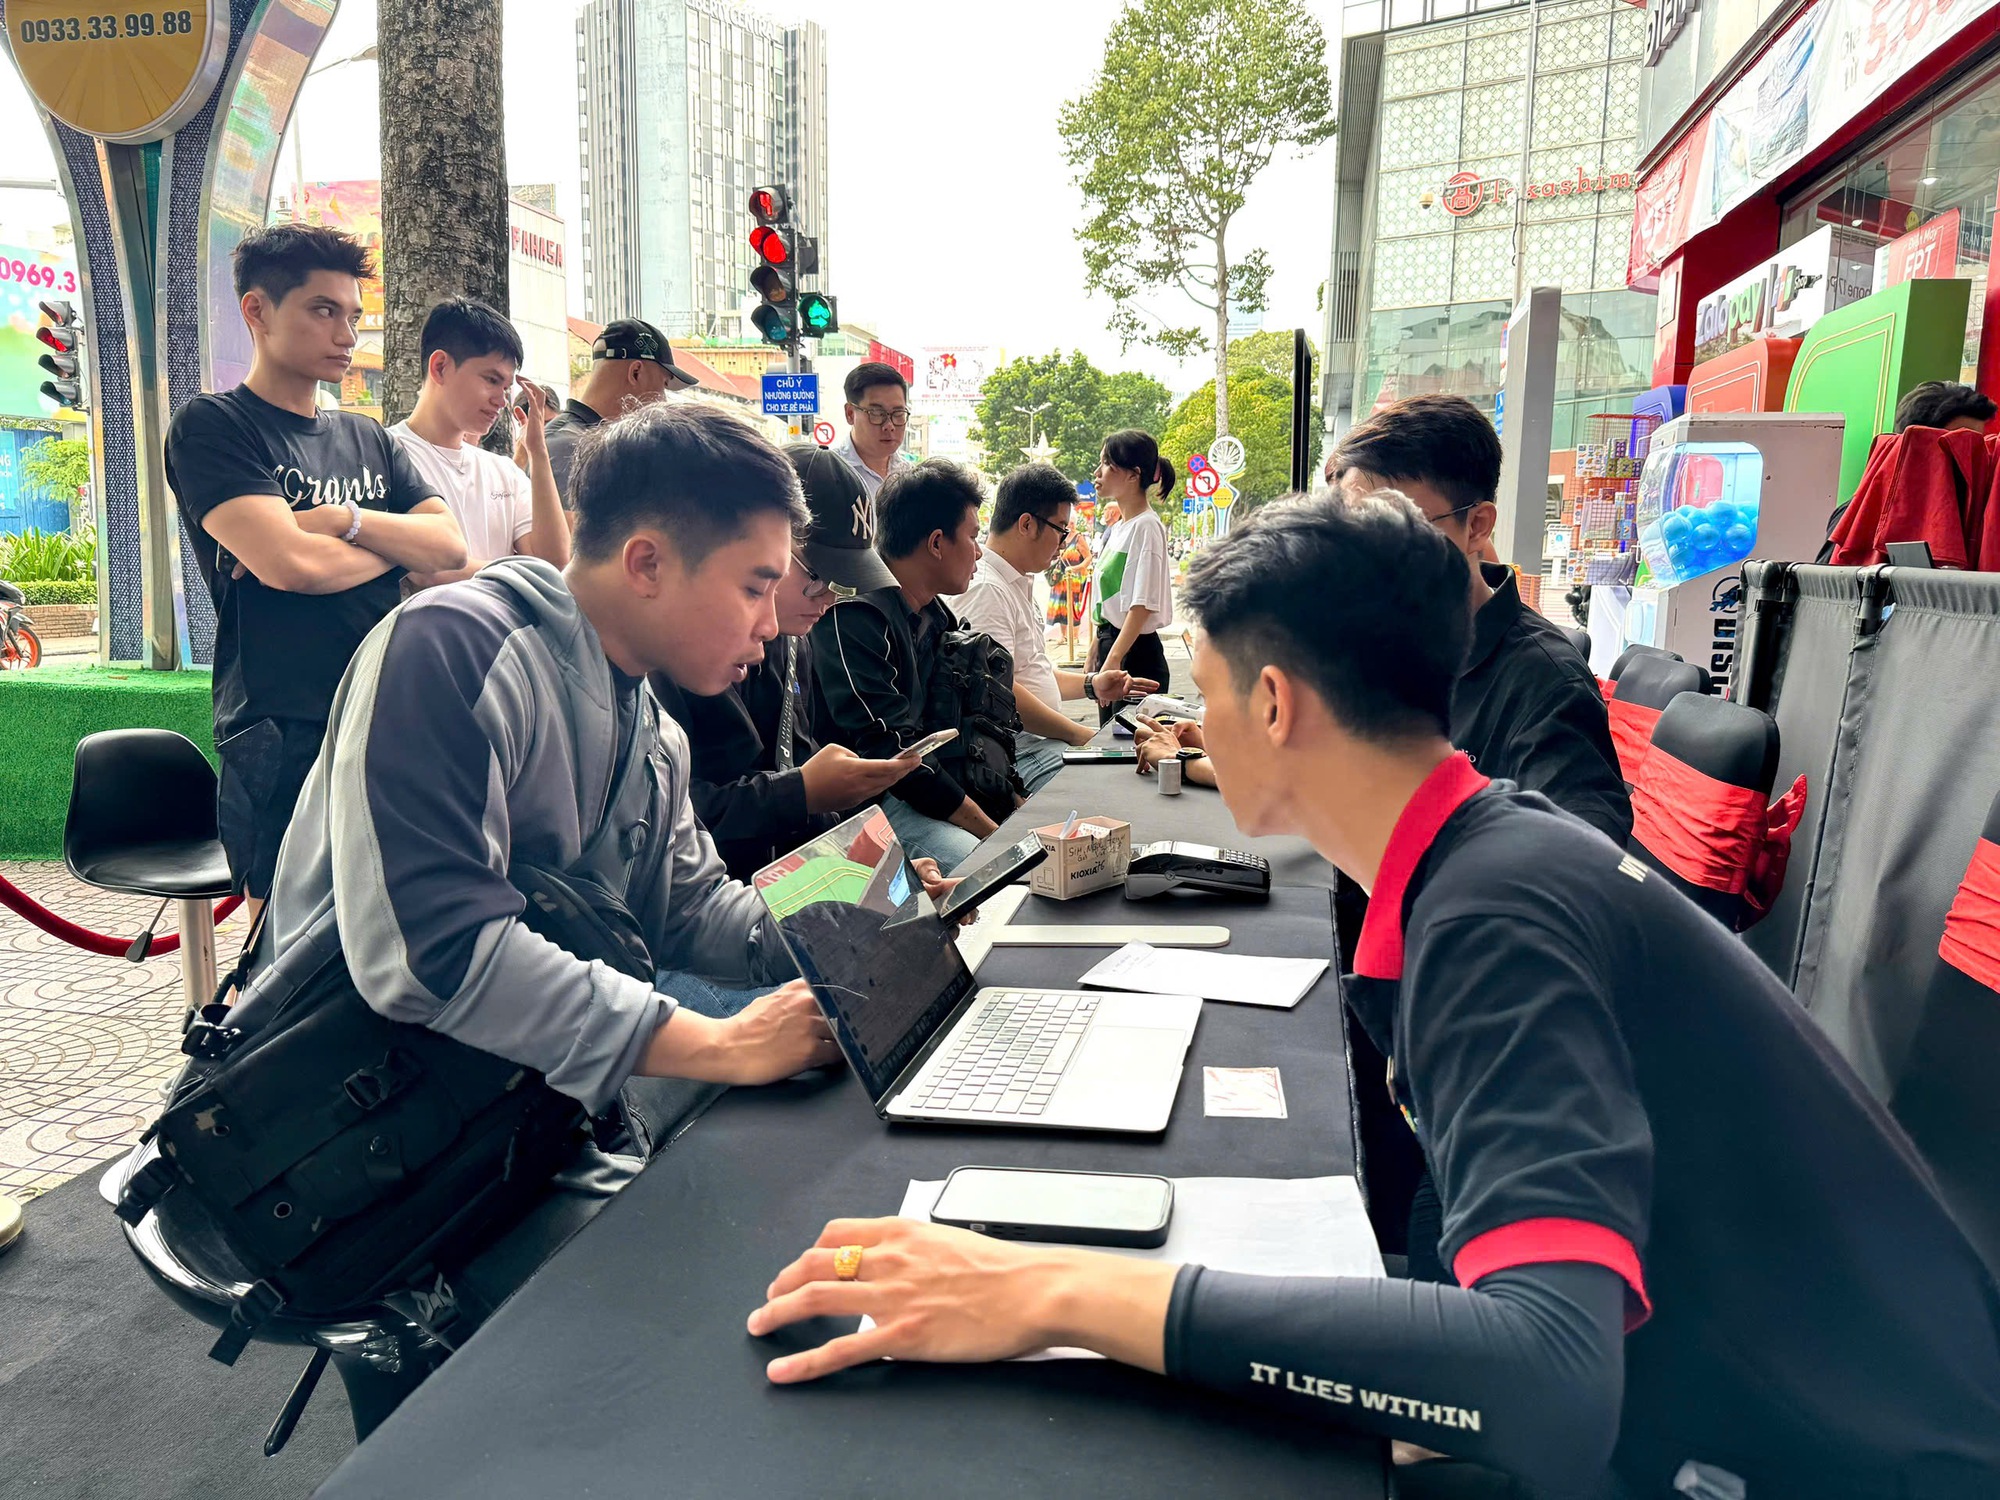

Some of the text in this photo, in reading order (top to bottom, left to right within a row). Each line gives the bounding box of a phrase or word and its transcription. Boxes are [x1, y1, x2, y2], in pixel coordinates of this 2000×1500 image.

[20, 10, 192, 43] 0933.33.99.88
[511, 226, 563, 268] FAHASA
[1903, 242, 1937, 282] FPT
[1695, 277, 1767, 347] Zalopay
[765, 403, 779, 412] CHO
[780, 403, 789, 412] XE
[851, 494, 873, 540] NY
[1070, 866, 1098, 880] KIOXIA
[1250, 1361, 1481, 1432] IT LIES WITHIN
